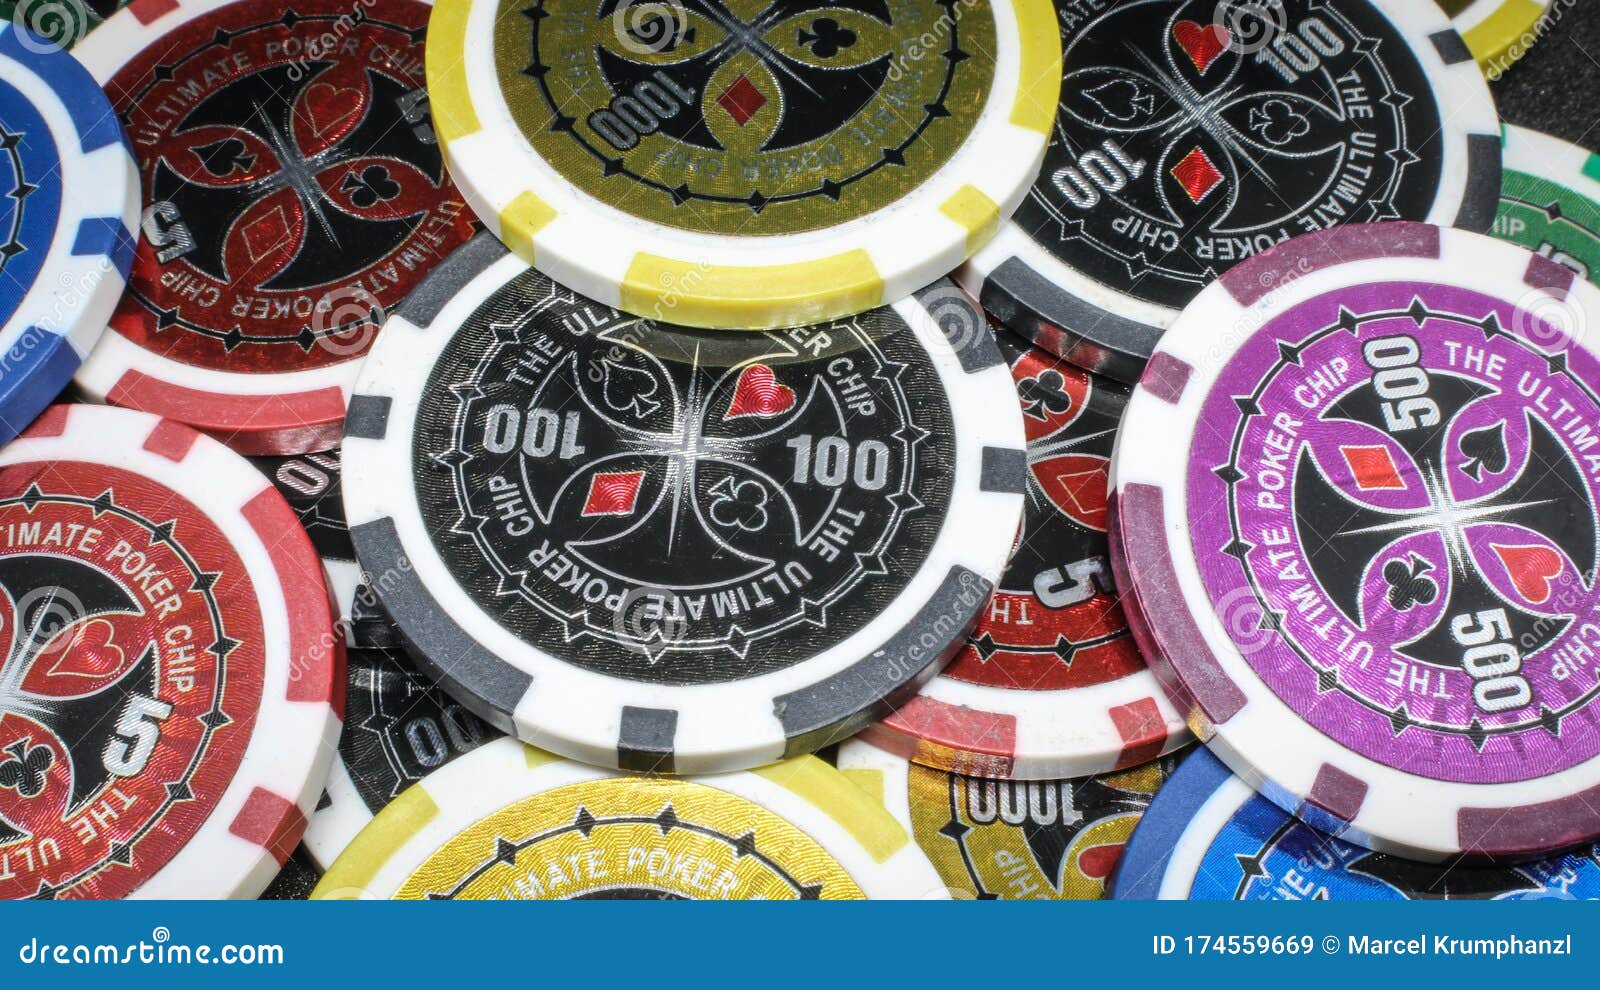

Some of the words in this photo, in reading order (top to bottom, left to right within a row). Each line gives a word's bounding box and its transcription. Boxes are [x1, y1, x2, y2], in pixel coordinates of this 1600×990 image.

[1254, 17, 1345, 84] 100
[136, 50, 250, 146] ULTIMATE
[588, 70, 697, 150] 1000
[1336, 69, 1374, 120] THE
[1051, 138, 1148, 209] 100
[1297, 131, 1377, 232] ULTIMATE
[141, 200, 199, 265] 5
[350, 200, 467, 302] ULTIMATE
[1111, 215, 1180, 252] CHIP
[159, 270, 221, 308] CHIP
[231, 291, 333, 320] POKER
[505, 334, 563, 386] THE
[827, 356, 877, 416] CHIP
[1294, 356, 1349, 409] CHIP
[1363, 335, 1441, 432] 500
[482, 403, 586, 460] 100
[1443, 340, 1507, 381] THE
[1517, 370, 1600, 483] ULTIMA
[786, 434, 890, 490] 100
[1257, 411, 1304, 510] POKER
[488, 475, 535, 537] CHIP
[808, 507, 866, 563] THE
[527, 538, 630, 613] POKER
[643, 560, 813, 621] ULTIMATE
[1033, 554, 1112, 609] 5
[1262, 526, 1374, 670] ULTIMATE
[0, 521, 102, 554] IMATE
[105, 539, 183, 621] POKER
[165, 624, 196, 692] CHIP
[989, 598, 1034, 626] TH
[1385, 657, 1453, 700] THE
[1451, 607, 1532, 711] 500
[1551, 622, 1600, 682] CHIP
[101, 691, 174, 777] 5
[70, 787, 138, 845] THE
[627, 846, 739, 900] POKER
